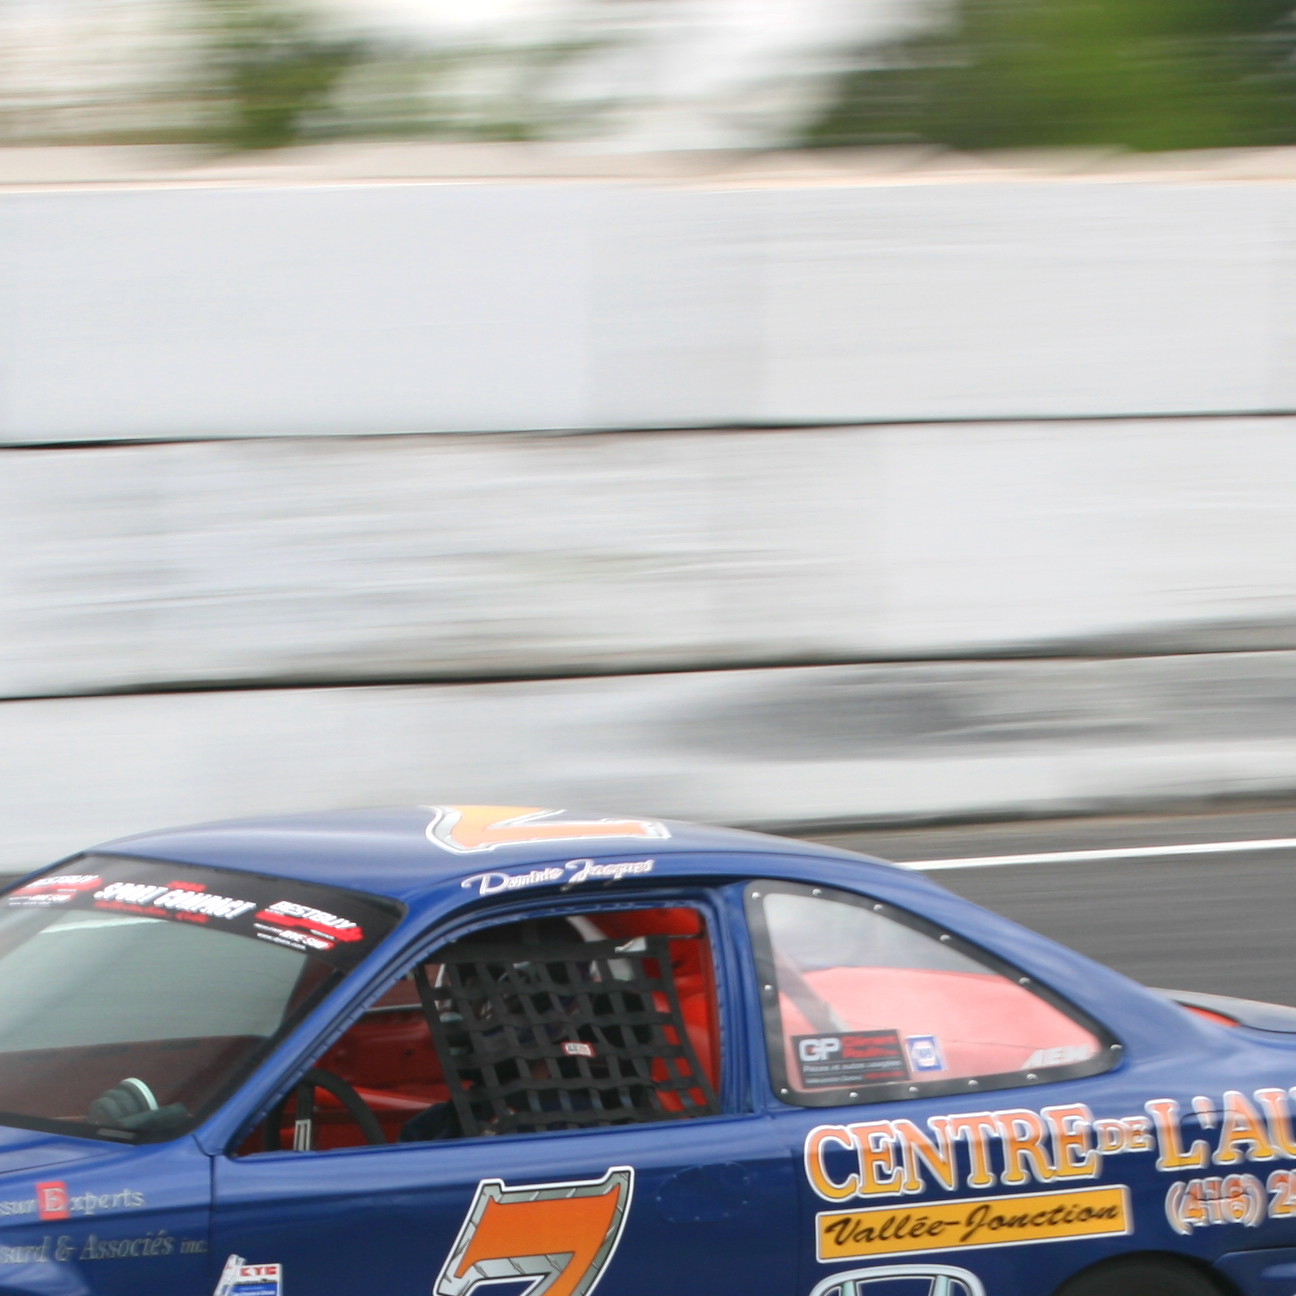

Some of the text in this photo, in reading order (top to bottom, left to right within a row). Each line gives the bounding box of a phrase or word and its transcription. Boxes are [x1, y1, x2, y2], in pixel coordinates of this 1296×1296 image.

[798, 1037, 841, 1062] GP
[805, 1103, 1103, 1203] CENTRE
[1093, 1116, 1155, 1155] DE
[824, 1203, 1120, 1247] Vallée-Jonction
[55, 1234, 76, 1262] &
[79, 1229, 176, 1261] Associés
